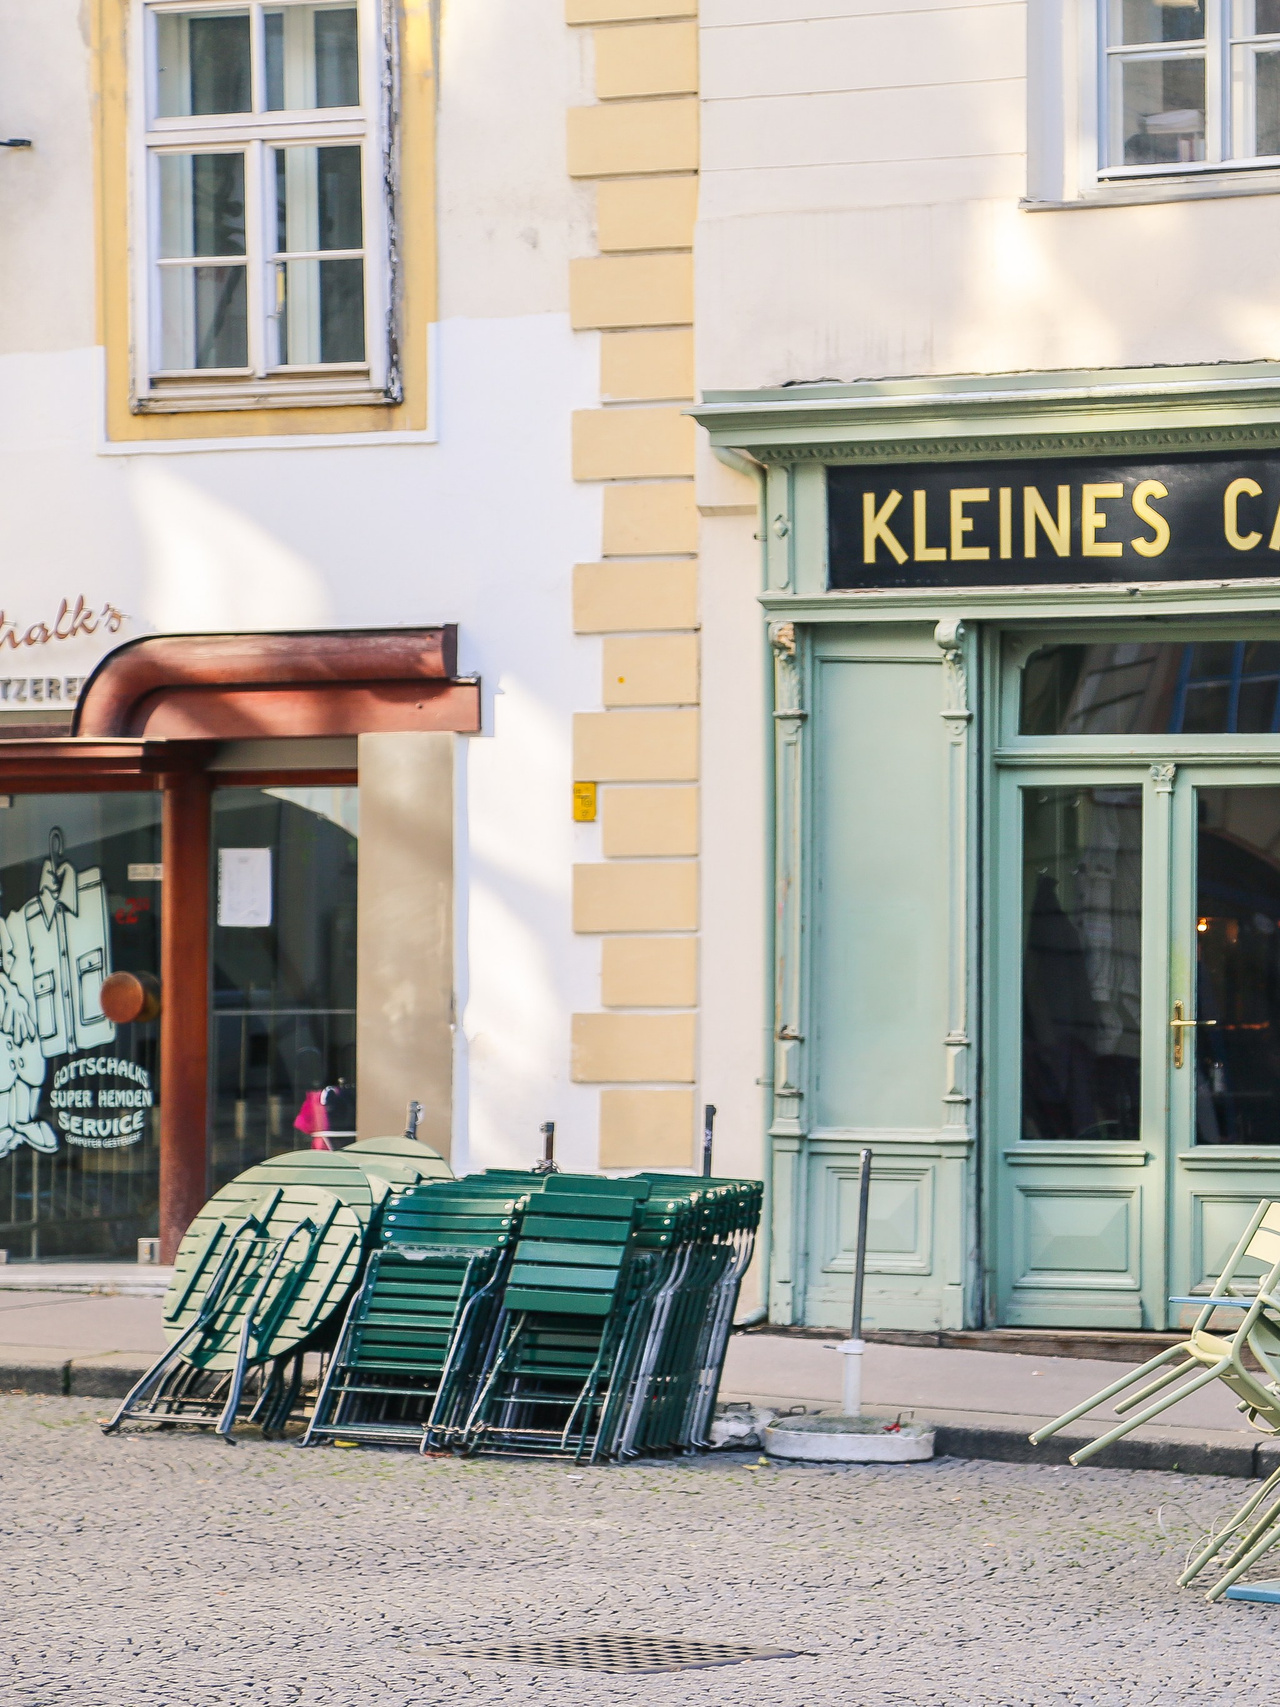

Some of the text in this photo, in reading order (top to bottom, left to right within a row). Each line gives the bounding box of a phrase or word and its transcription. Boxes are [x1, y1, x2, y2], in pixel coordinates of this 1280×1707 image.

[862, 478, 1172, 565] KLEINES
[53, 1056, 149, 1090] GOTTSCHALKS
[49, 1089, 153, 1108] SUPER HEMDEN
[58, 1109, 145, 1137] SERVICE
